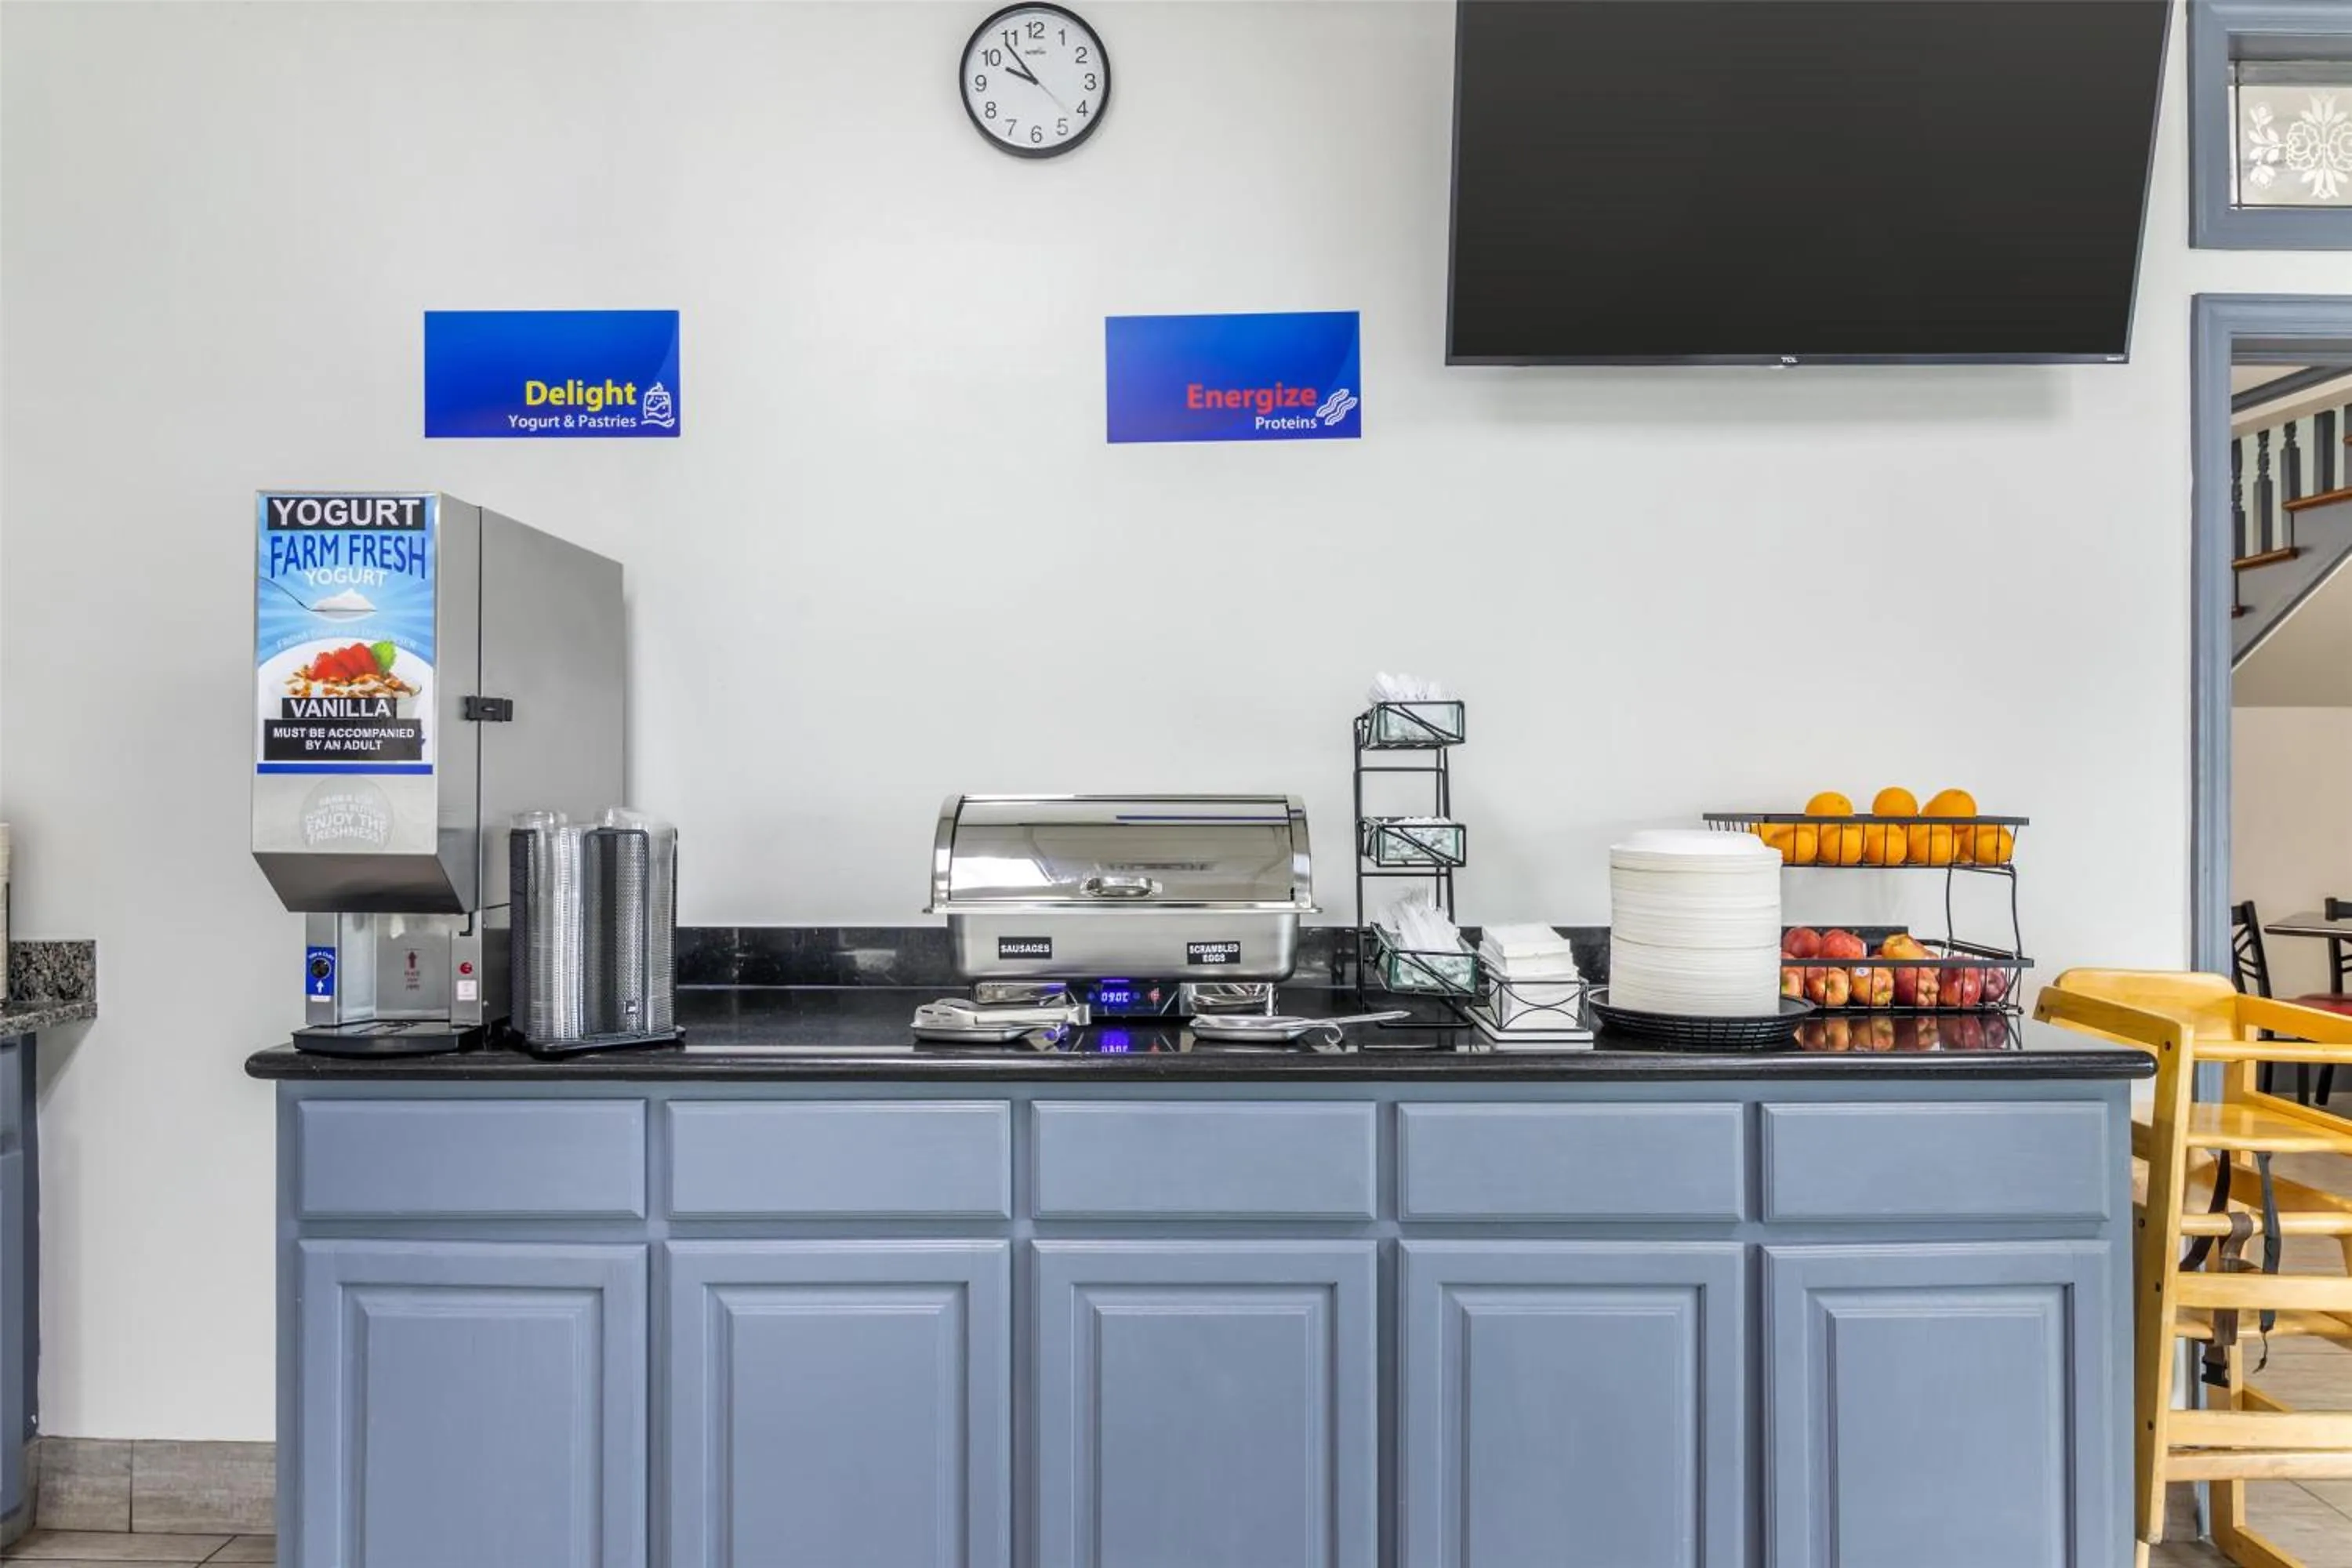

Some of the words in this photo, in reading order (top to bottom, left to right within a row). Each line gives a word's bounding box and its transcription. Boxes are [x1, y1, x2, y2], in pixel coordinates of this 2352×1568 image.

[1001, 30, 1018, 46] 11
[1025, 22, 1045, 39] 12
[1058, 29, 1065, 46] 1
[982, 49, 1001, 66] 10
[1075, 46, 1087, 64] 2
[975, 74, 986, 92] 9
[1084, 73, 1097, 90] 3
[985, 101, 996, 118] 8
[1076, 100, 1088, 117] 4
[1005, 119, 1017, 136] 7
[1031, 125, 1043, 143] 6
[1057, 118, 1068, 136] 5
[525, 379, 637, 412] Delight
[1186, 382, 1317, 414] Energize
[509, 415, 560, 431] Yogurt
[563, 415, 575, 428] &
[578, 415, 637, 428] Pastries
[1255, 416, 1317, 430] Proteins
[273, 499, 420, 527] YOGURT
[270, 534, 339, 579] FARM
[349, 534, 426, 579] FRESH
[304, 567, 389, 588] YOGURT
[290, 699, 391, 717] VANILLA
[273, 728, 306, 738] MUST
[309, 728, 325, 738] BE
[328, 728, 415, 739] ACCOMPANIED
[305, 739, 321, 750] BY
[324, 739, 340, 750] AN
[343, 739, 383, 750] ADULT
[1000, 943, 1050, 953] SAUSAGES
[1189, 943, 1239, 954] SCRAMBLED
